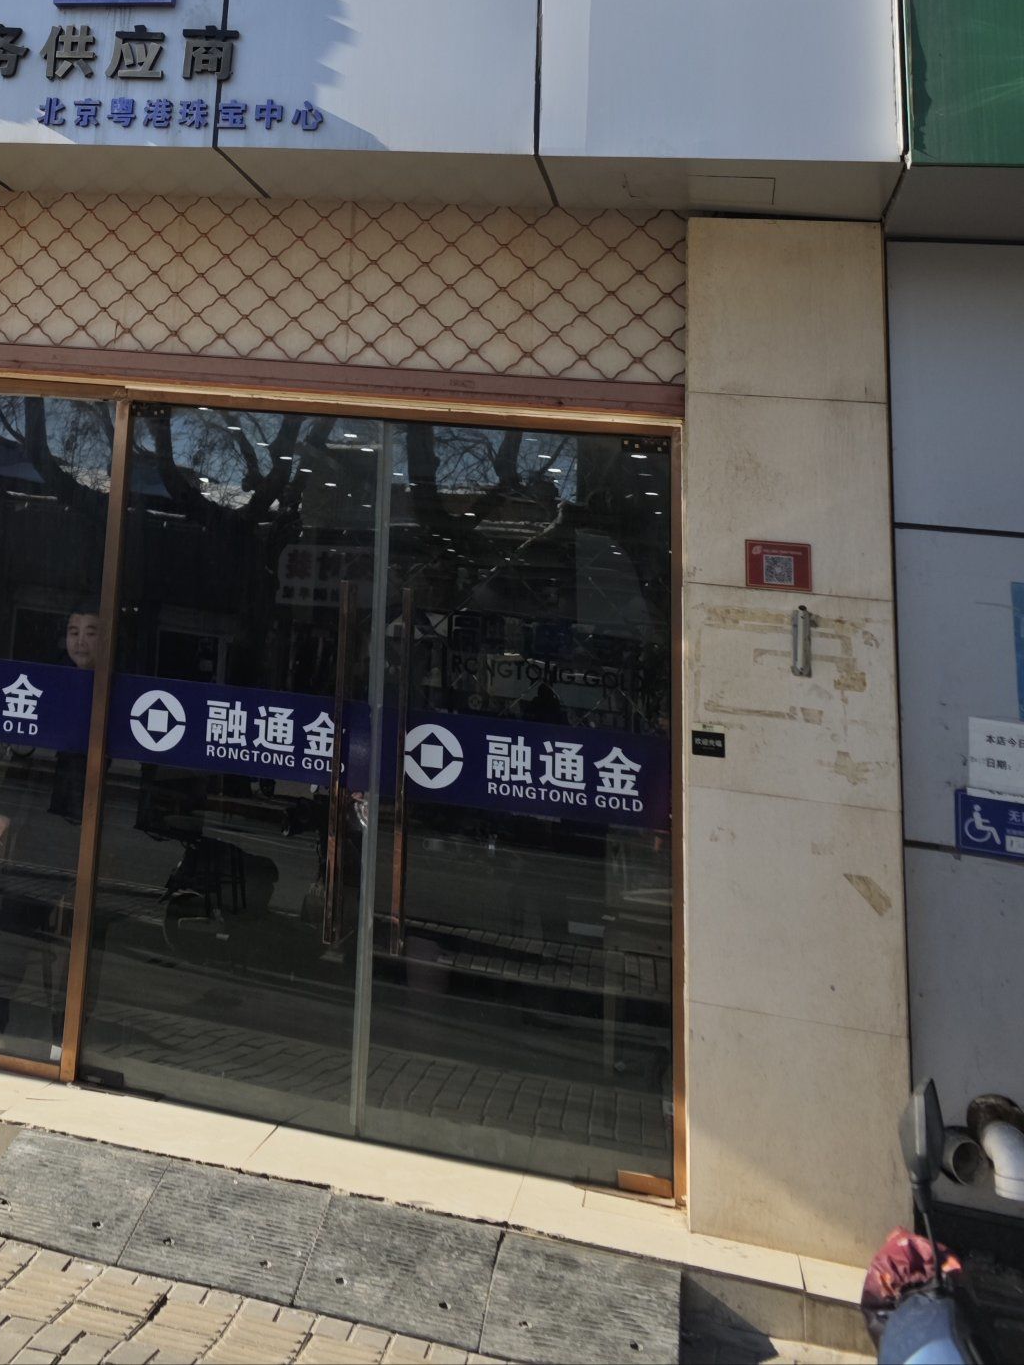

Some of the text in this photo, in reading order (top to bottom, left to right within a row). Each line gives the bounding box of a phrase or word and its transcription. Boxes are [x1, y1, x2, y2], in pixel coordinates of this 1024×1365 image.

[37, 96, 324, 132] 北京粤港珠宝中心
[205, 698, 347, 757] 融通金
[205, 743, 296, 769] RONGTONG
[485, 734, 643, 797] 融通金
[487, 782, 645, 813] RONGTONG GOLD
